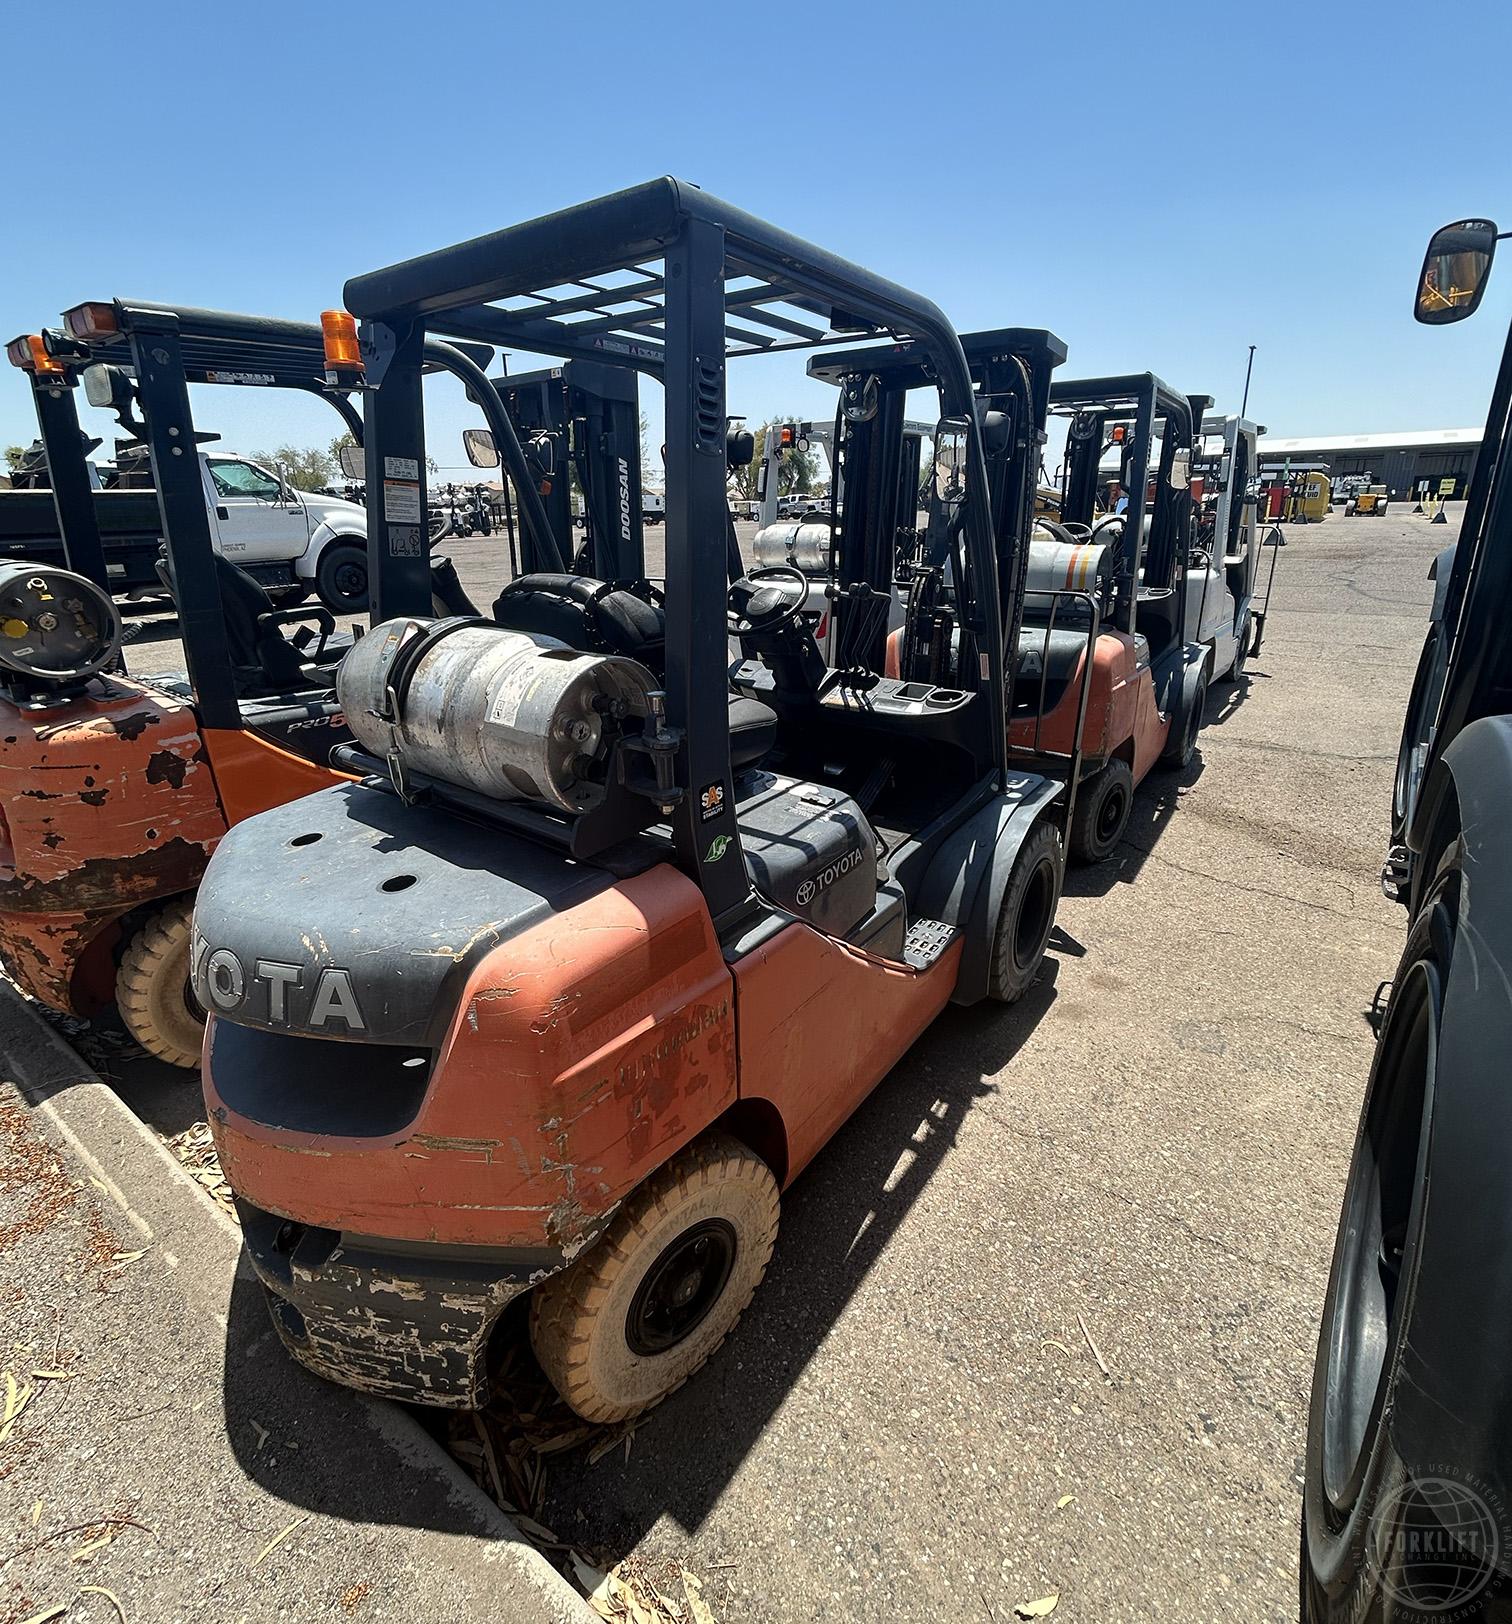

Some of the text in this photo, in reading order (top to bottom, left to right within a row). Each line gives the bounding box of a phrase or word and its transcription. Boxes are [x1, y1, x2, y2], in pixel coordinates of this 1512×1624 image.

[618, 457, 631, 541] DOOSAN
[701, 785, 724, 808] SAS
[816, 847, 863, 890] TOYOTA
